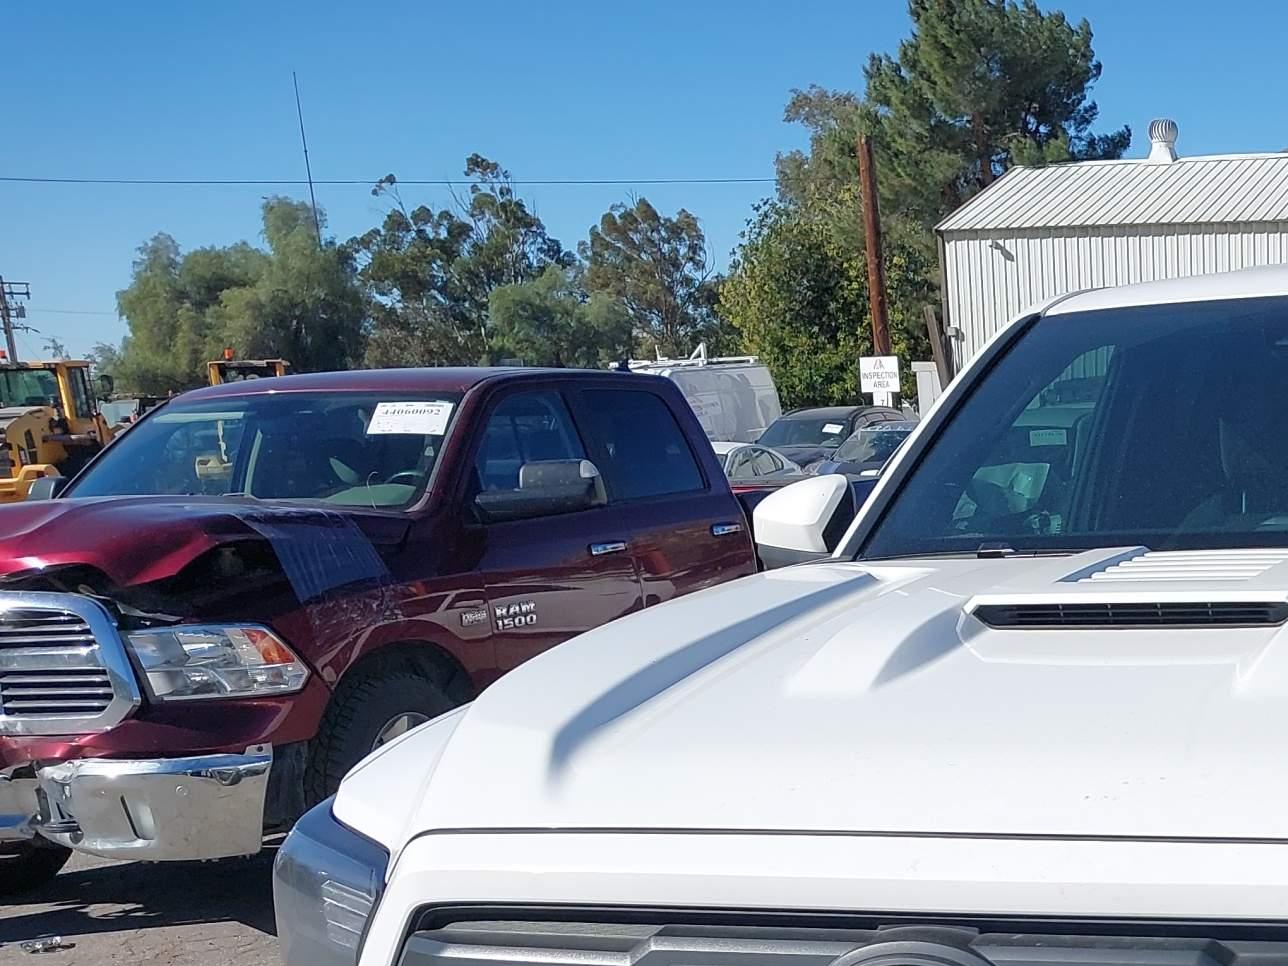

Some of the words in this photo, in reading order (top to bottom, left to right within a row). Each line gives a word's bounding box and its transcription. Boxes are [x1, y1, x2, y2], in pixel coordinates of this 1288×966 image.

[861, 371, 898, 380] INSPECTION
[873, 380, 890, 388] AREA
[494, 602, 536, 618] RAM
[496, 614, 537, 631] 1500
